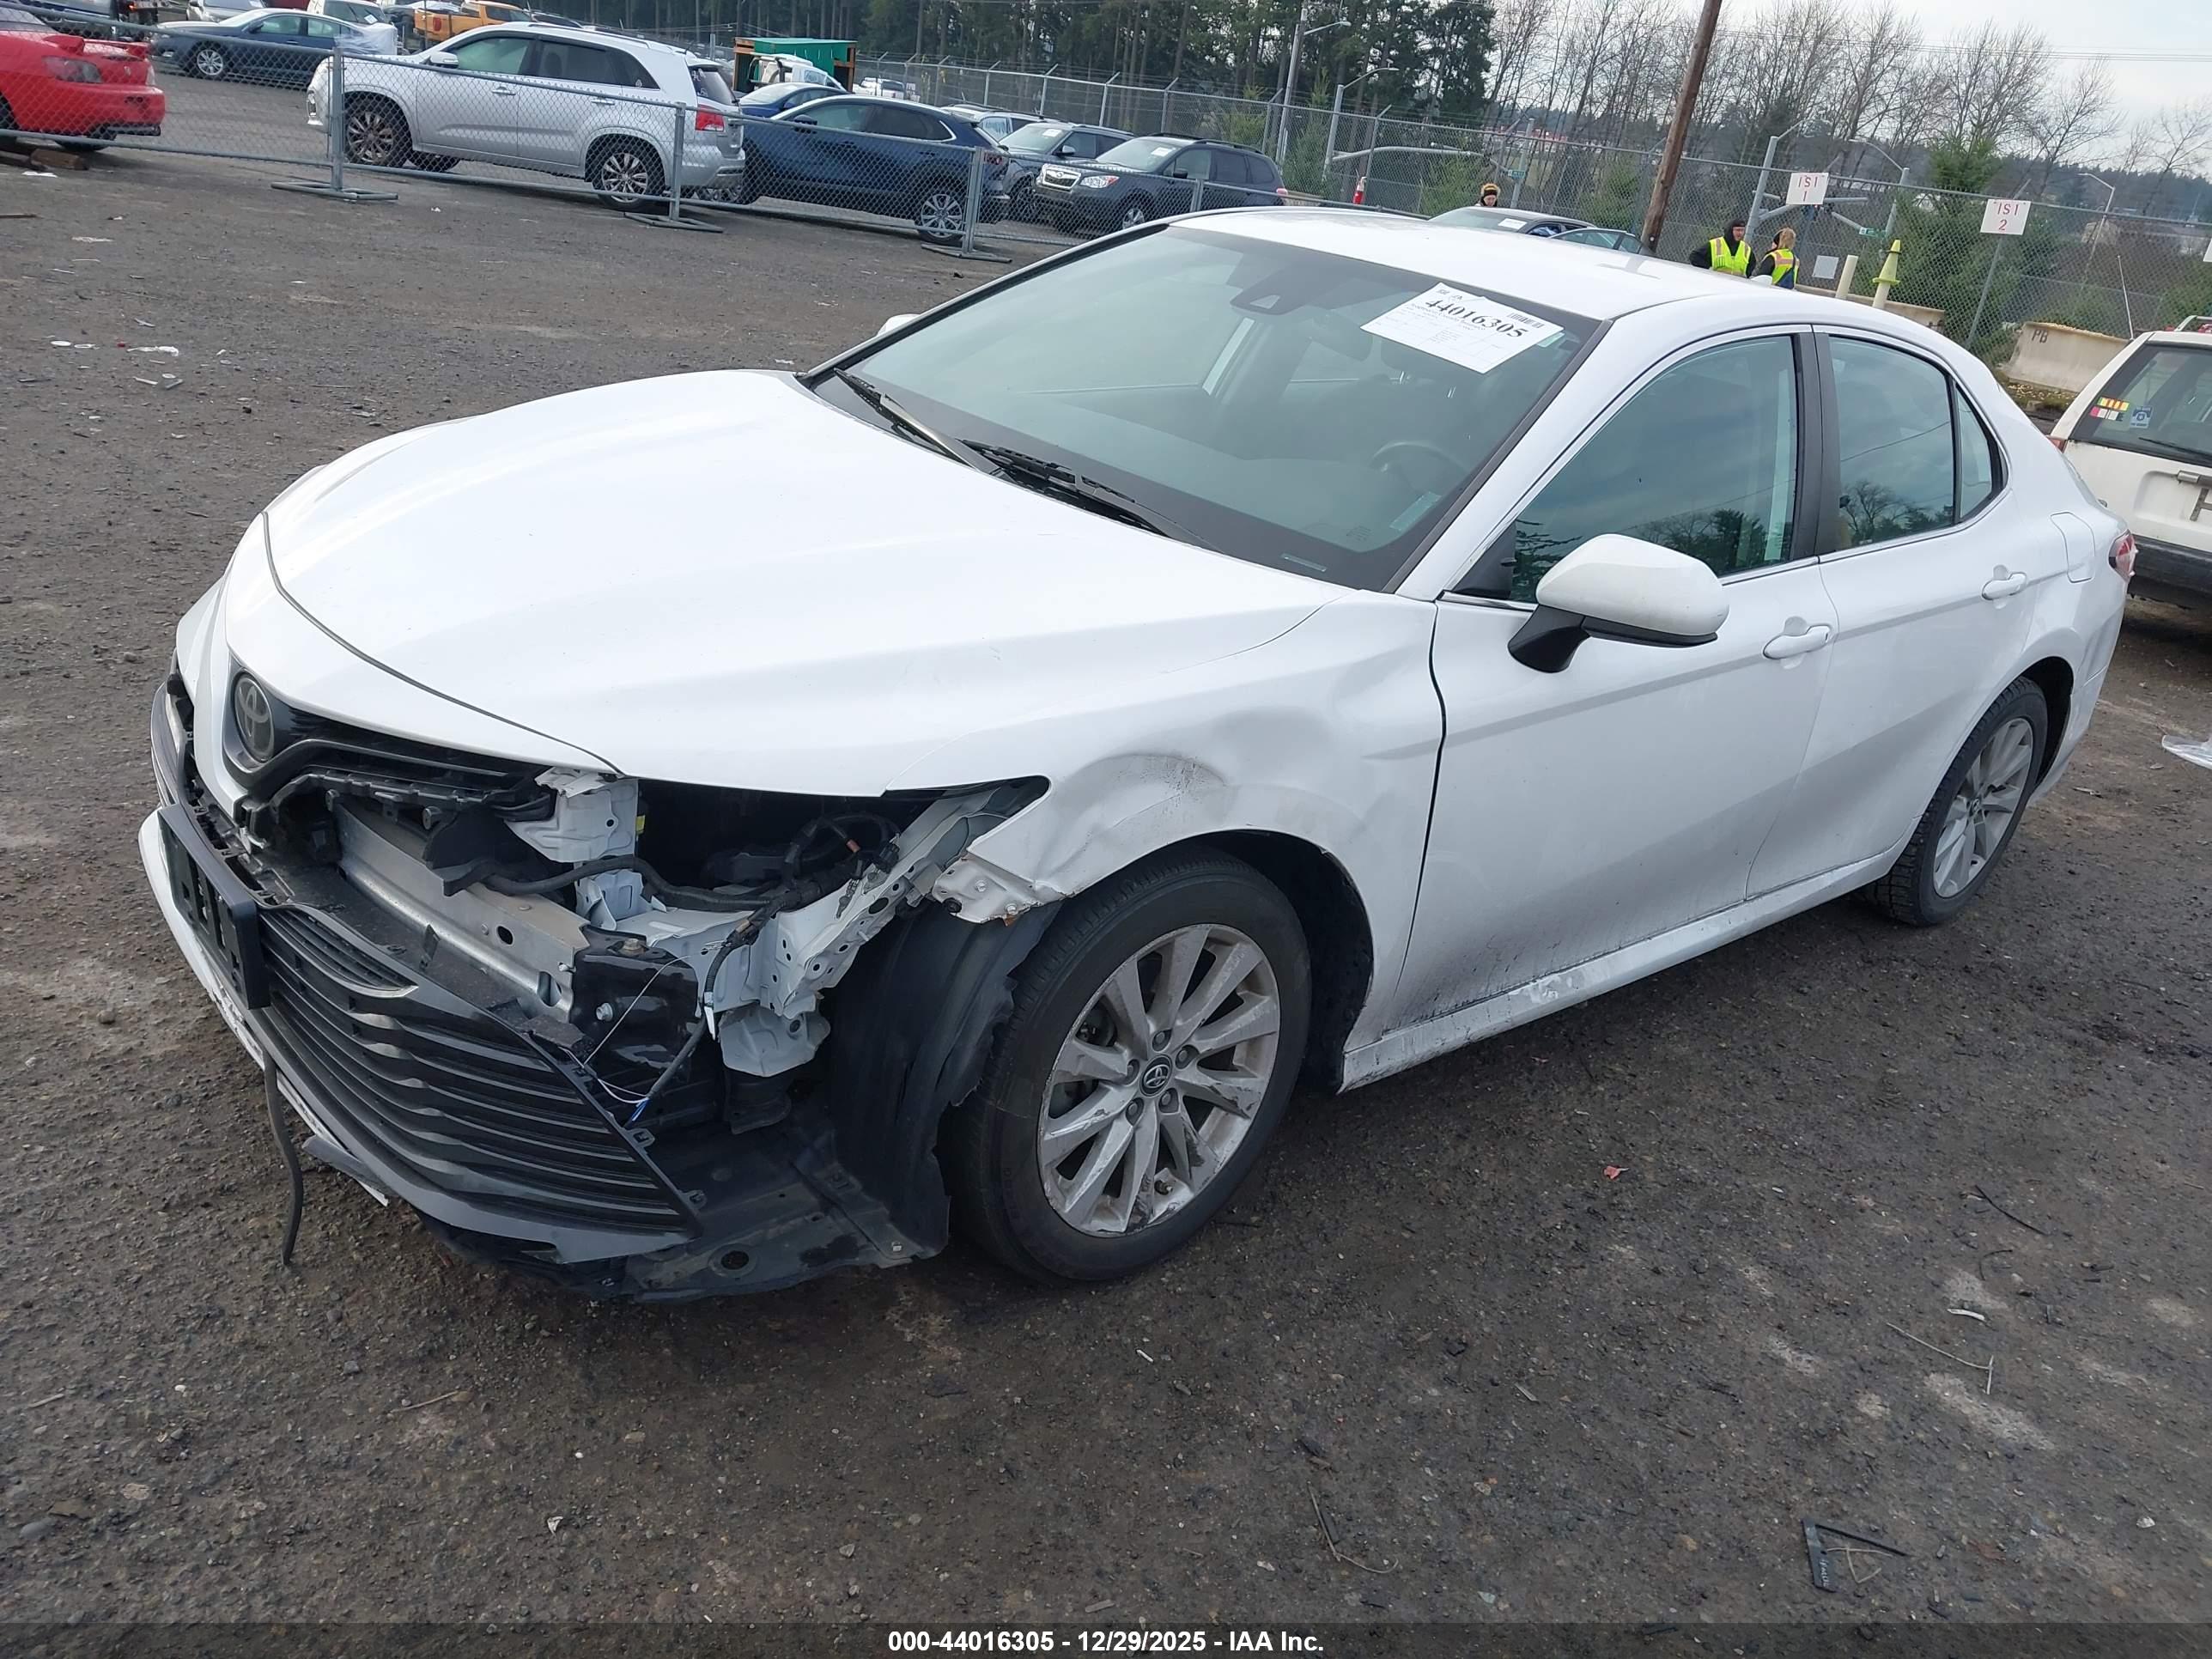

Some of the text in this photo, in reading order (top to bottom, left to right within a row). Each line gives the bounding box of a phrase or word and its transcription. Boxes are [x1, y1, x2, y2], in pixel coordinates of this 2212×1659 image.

[1998, 219, 2008, 231] 2
[1425, 300, 1528, 337] 44016305
[2032, 329, 2048, 343] PB
